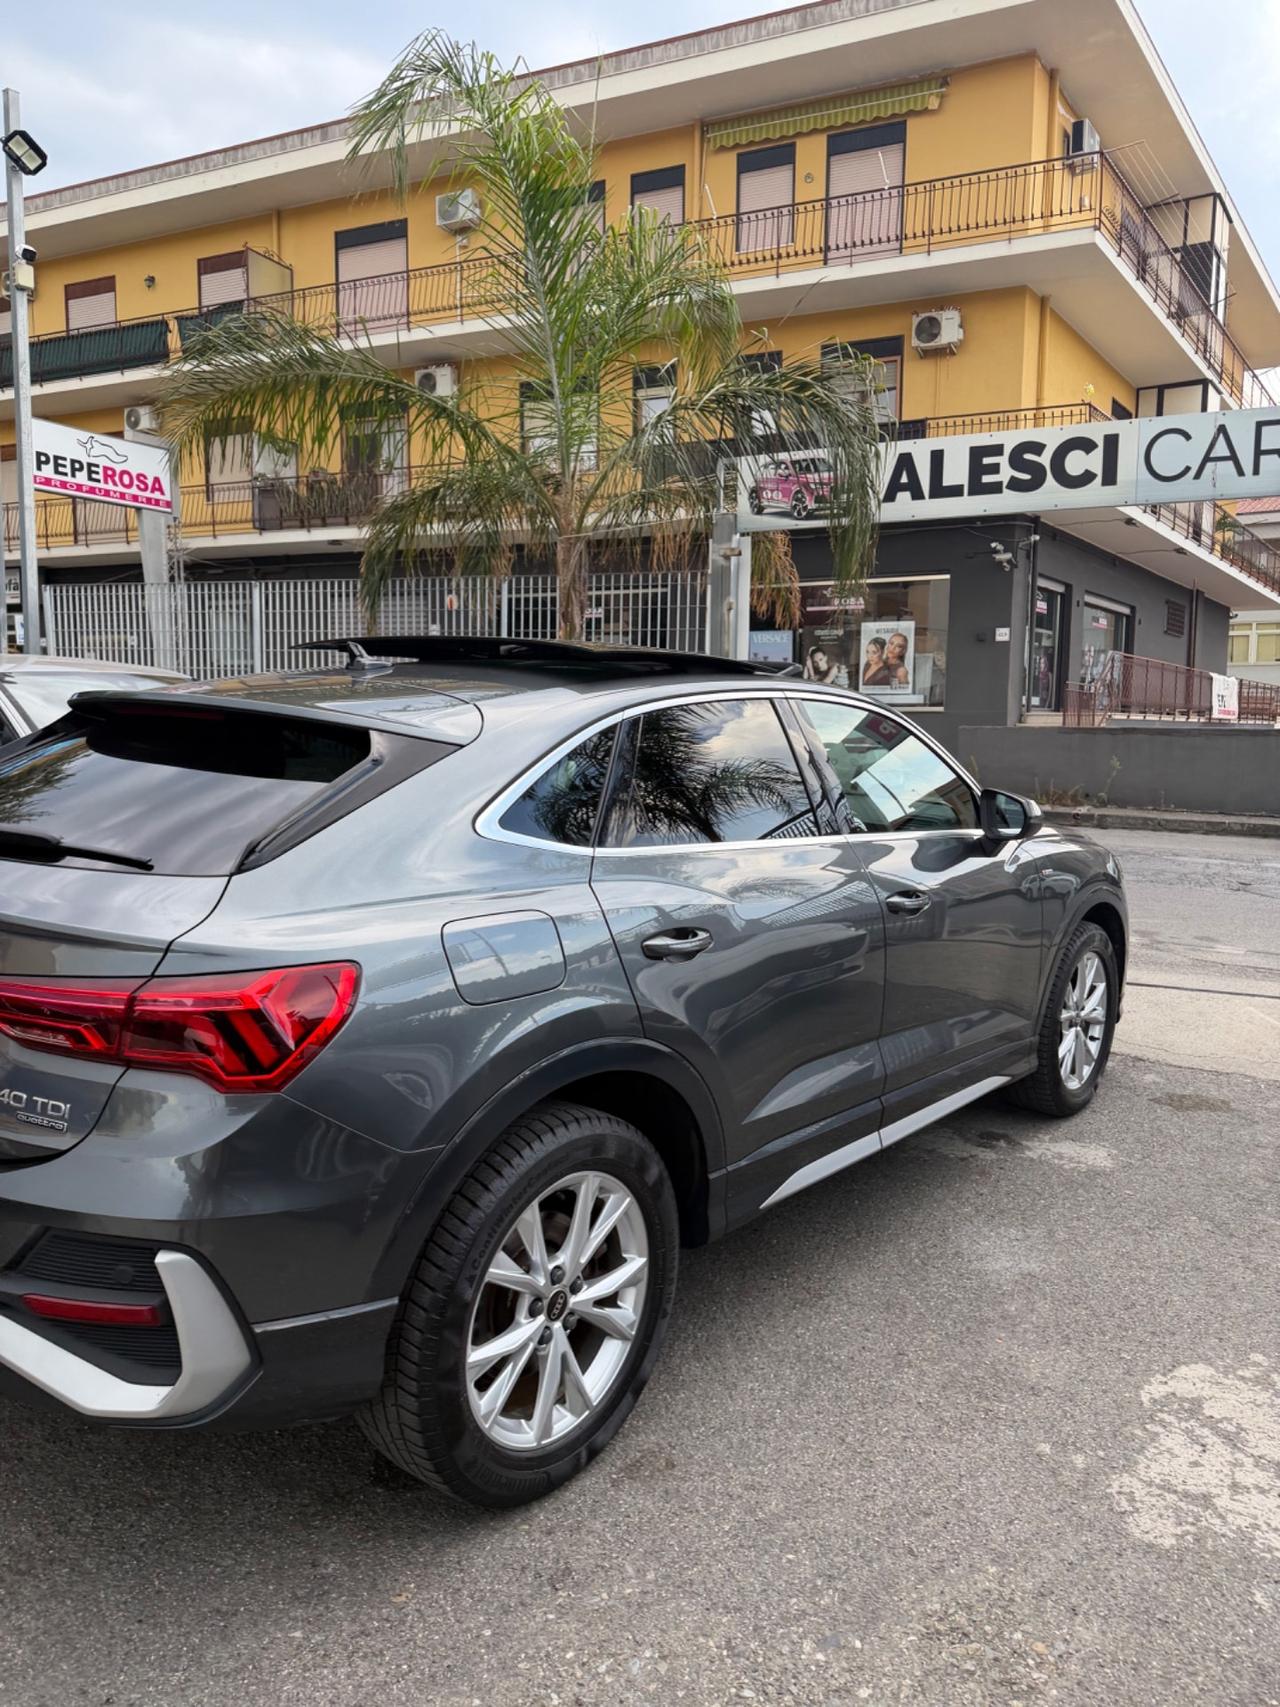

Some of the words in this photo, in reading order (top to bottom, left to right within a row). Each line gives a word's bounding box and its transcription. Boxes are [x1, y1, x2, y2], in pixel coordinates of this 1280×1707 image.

[35, 451, 165, 496] PEPEROSA
[882, 432, 1120, 503] ALESCI
[36, 476, 167, 508] PROFUMERIE
[0, 1089, 27, 1108] 40
[33, 1096, 71, 1119] TDI
[16, 1112, 65, 1131] quattro
